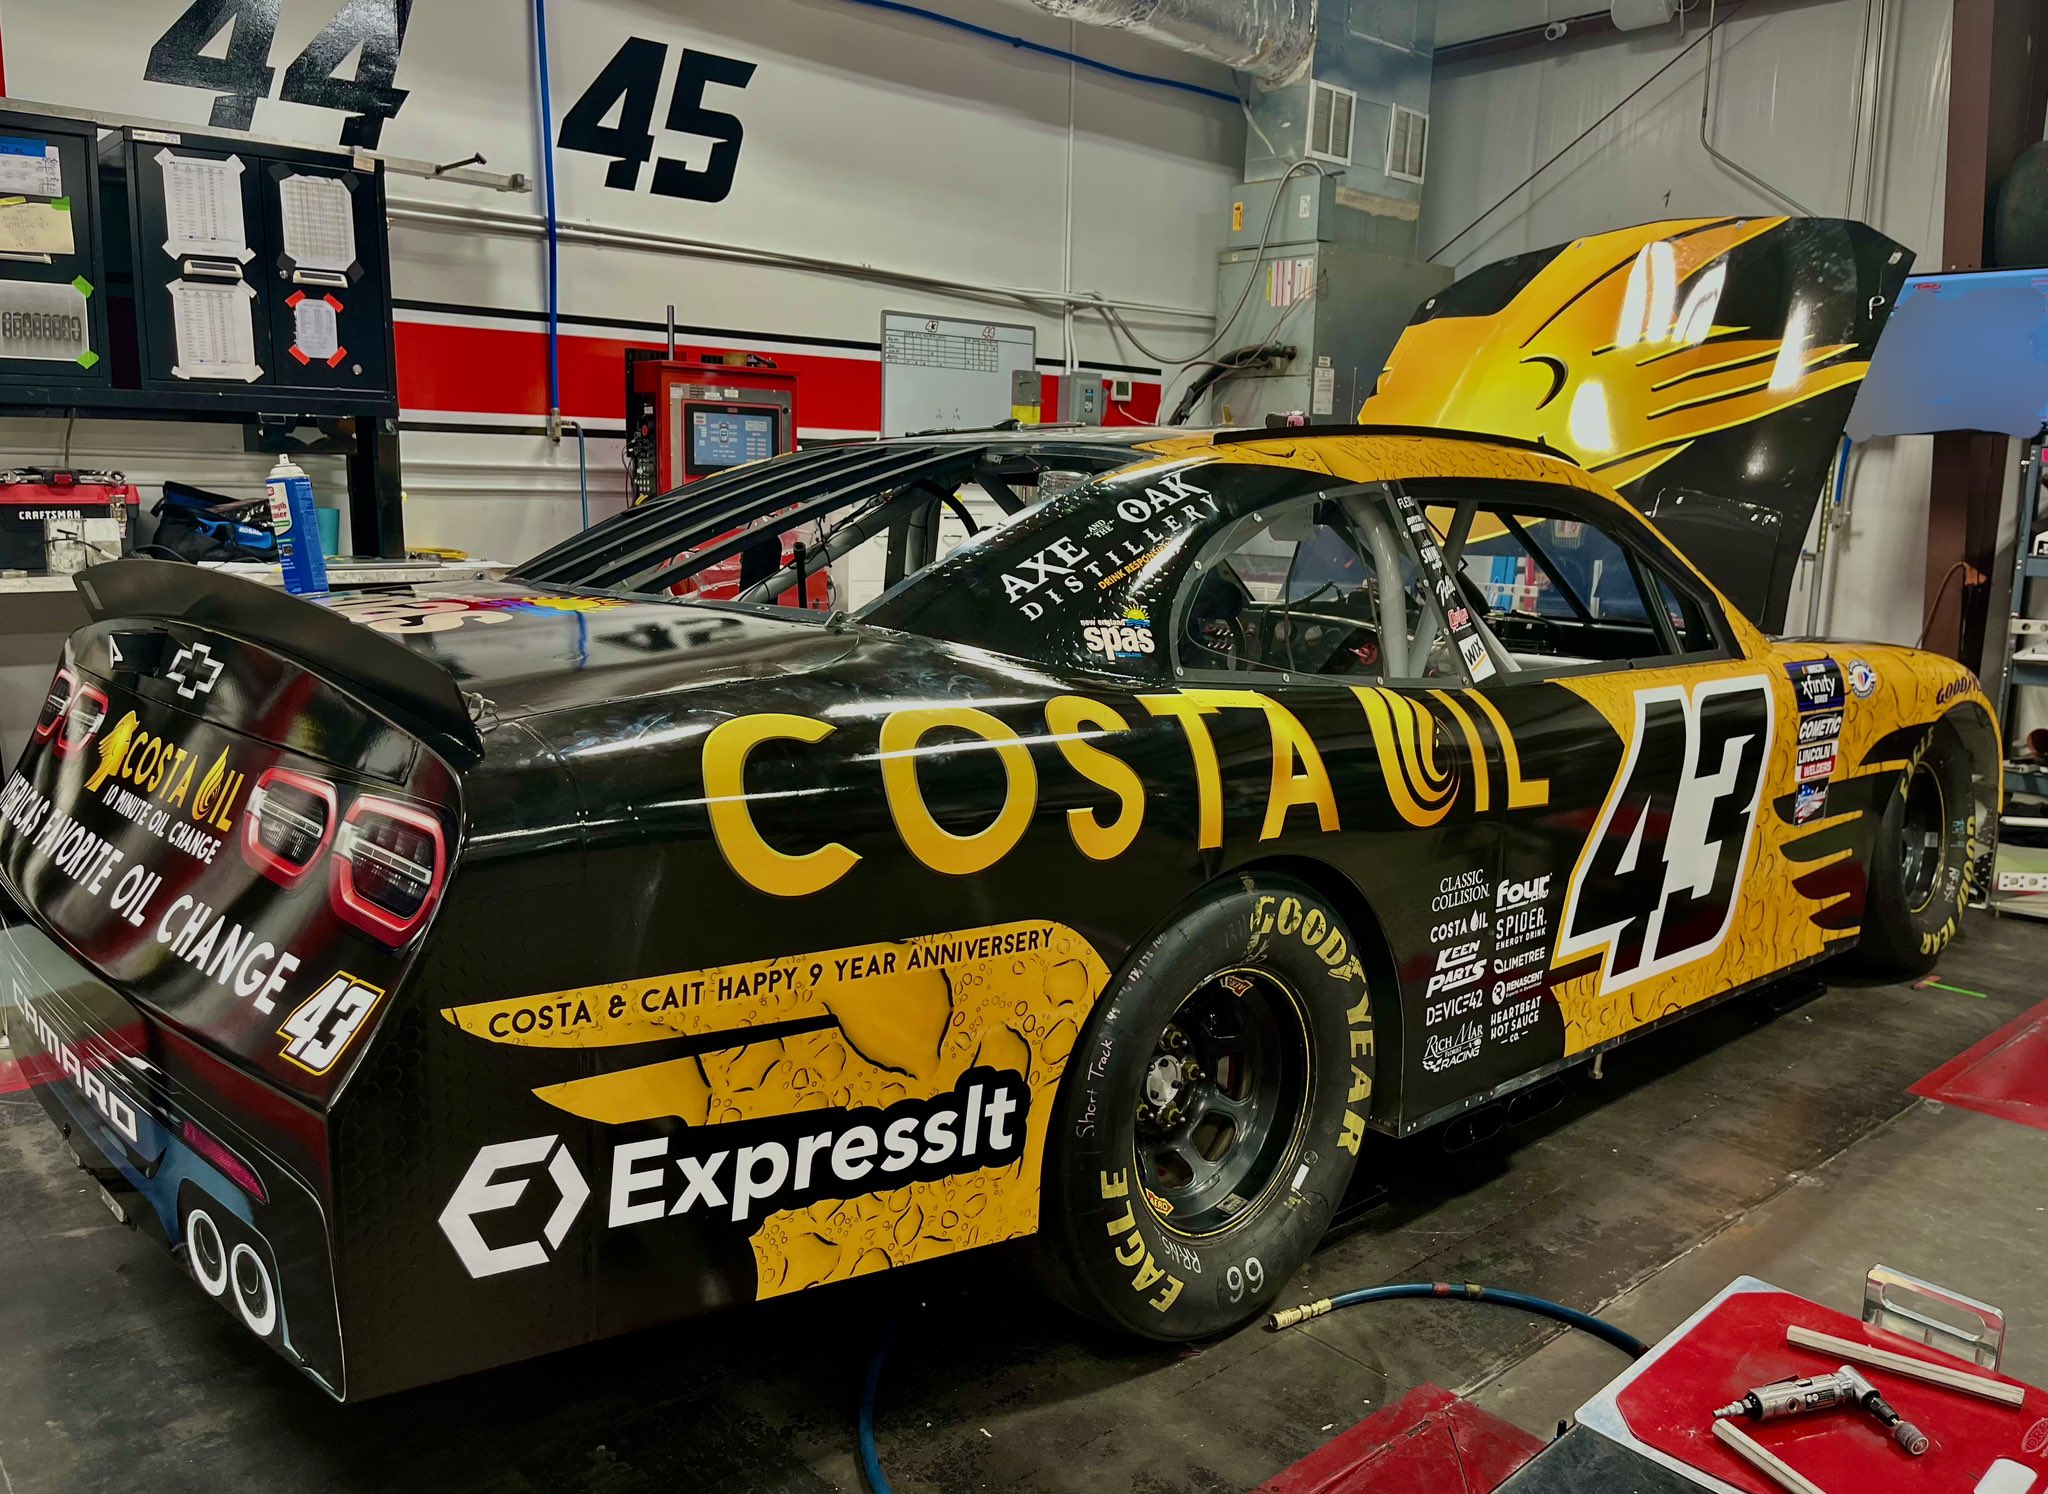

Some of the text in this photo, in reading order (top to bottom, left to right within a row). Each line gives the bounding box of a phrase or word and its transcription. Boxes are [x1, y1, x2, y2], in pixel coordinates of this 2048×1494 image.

[143, 0, 410, 150] 44
[557, 36, 758, 203] 45
[18, 510, 81, 520] CRAFTSMAN
[1000, 472, 1210, 604] AXE AND THE OAK
[1019, 494, 1220, 622] DISTILLERY
[1097, 569, 1126, 590] DRINK
[1083, 626, 1155, 660] spas
[1464, 638, 1485, 666] WIX
[1801, 674, 1836, 700] xfinity
[1799, 716, 1842, 740] COMETIC
[122, 731, 199, 809] COSTA
[1798, 745, 1832, 765] LINCOLN
[1803, 761, 1832, 777] WELDERS
[702, 686, 1342, 897] COSTA
[102, 784, 222, 865] 10 MINUTE OIL CHANGE
[1552, 674, 1774, 998] 43
[0, 769, 301, 1015] MERICAS FAVORITE OIL CHANGE
[1440, 868, 1485, 894] CLASSIC
[1496, 874, 1550, 908] four
[1430, 918, 1468, 943] COSTA
[1495, 927, 1546, 951] ENERGY DRINK
[1435, 940, 1480, 972] KEEN
[1503, 946, 1546, 973] LIMETREE
[488, 928, 1055, 1038] COSTA & CAIT HAPPY 9 YEAR ANNIVERSERY
[1425, 958, 1487, 999] PARTS
[1506, 970, 1544, 992] RENASCENT
[278, 972, 384, 1075] 43
[1425, 989, 1483, 1026] DEVICE42
[1490, 996, 1542, 1026] HEARTBEAT
[1250, 896, 1376, 1157] GOODYEAR
[1490, 1010, 1539, 1040] HOT SAUCE
[1509, 1032, 1520, 1043] CO.
[12, 977, 138, 1143] CAMARO
[1440, 1046, 1480, 1071] RACING
[1075, 1039, 1113, 1137] Short Track
[607, 1084, 1017, 1229] ExpressIt
[1100, 1167, 1185, 1313] EAGLE
